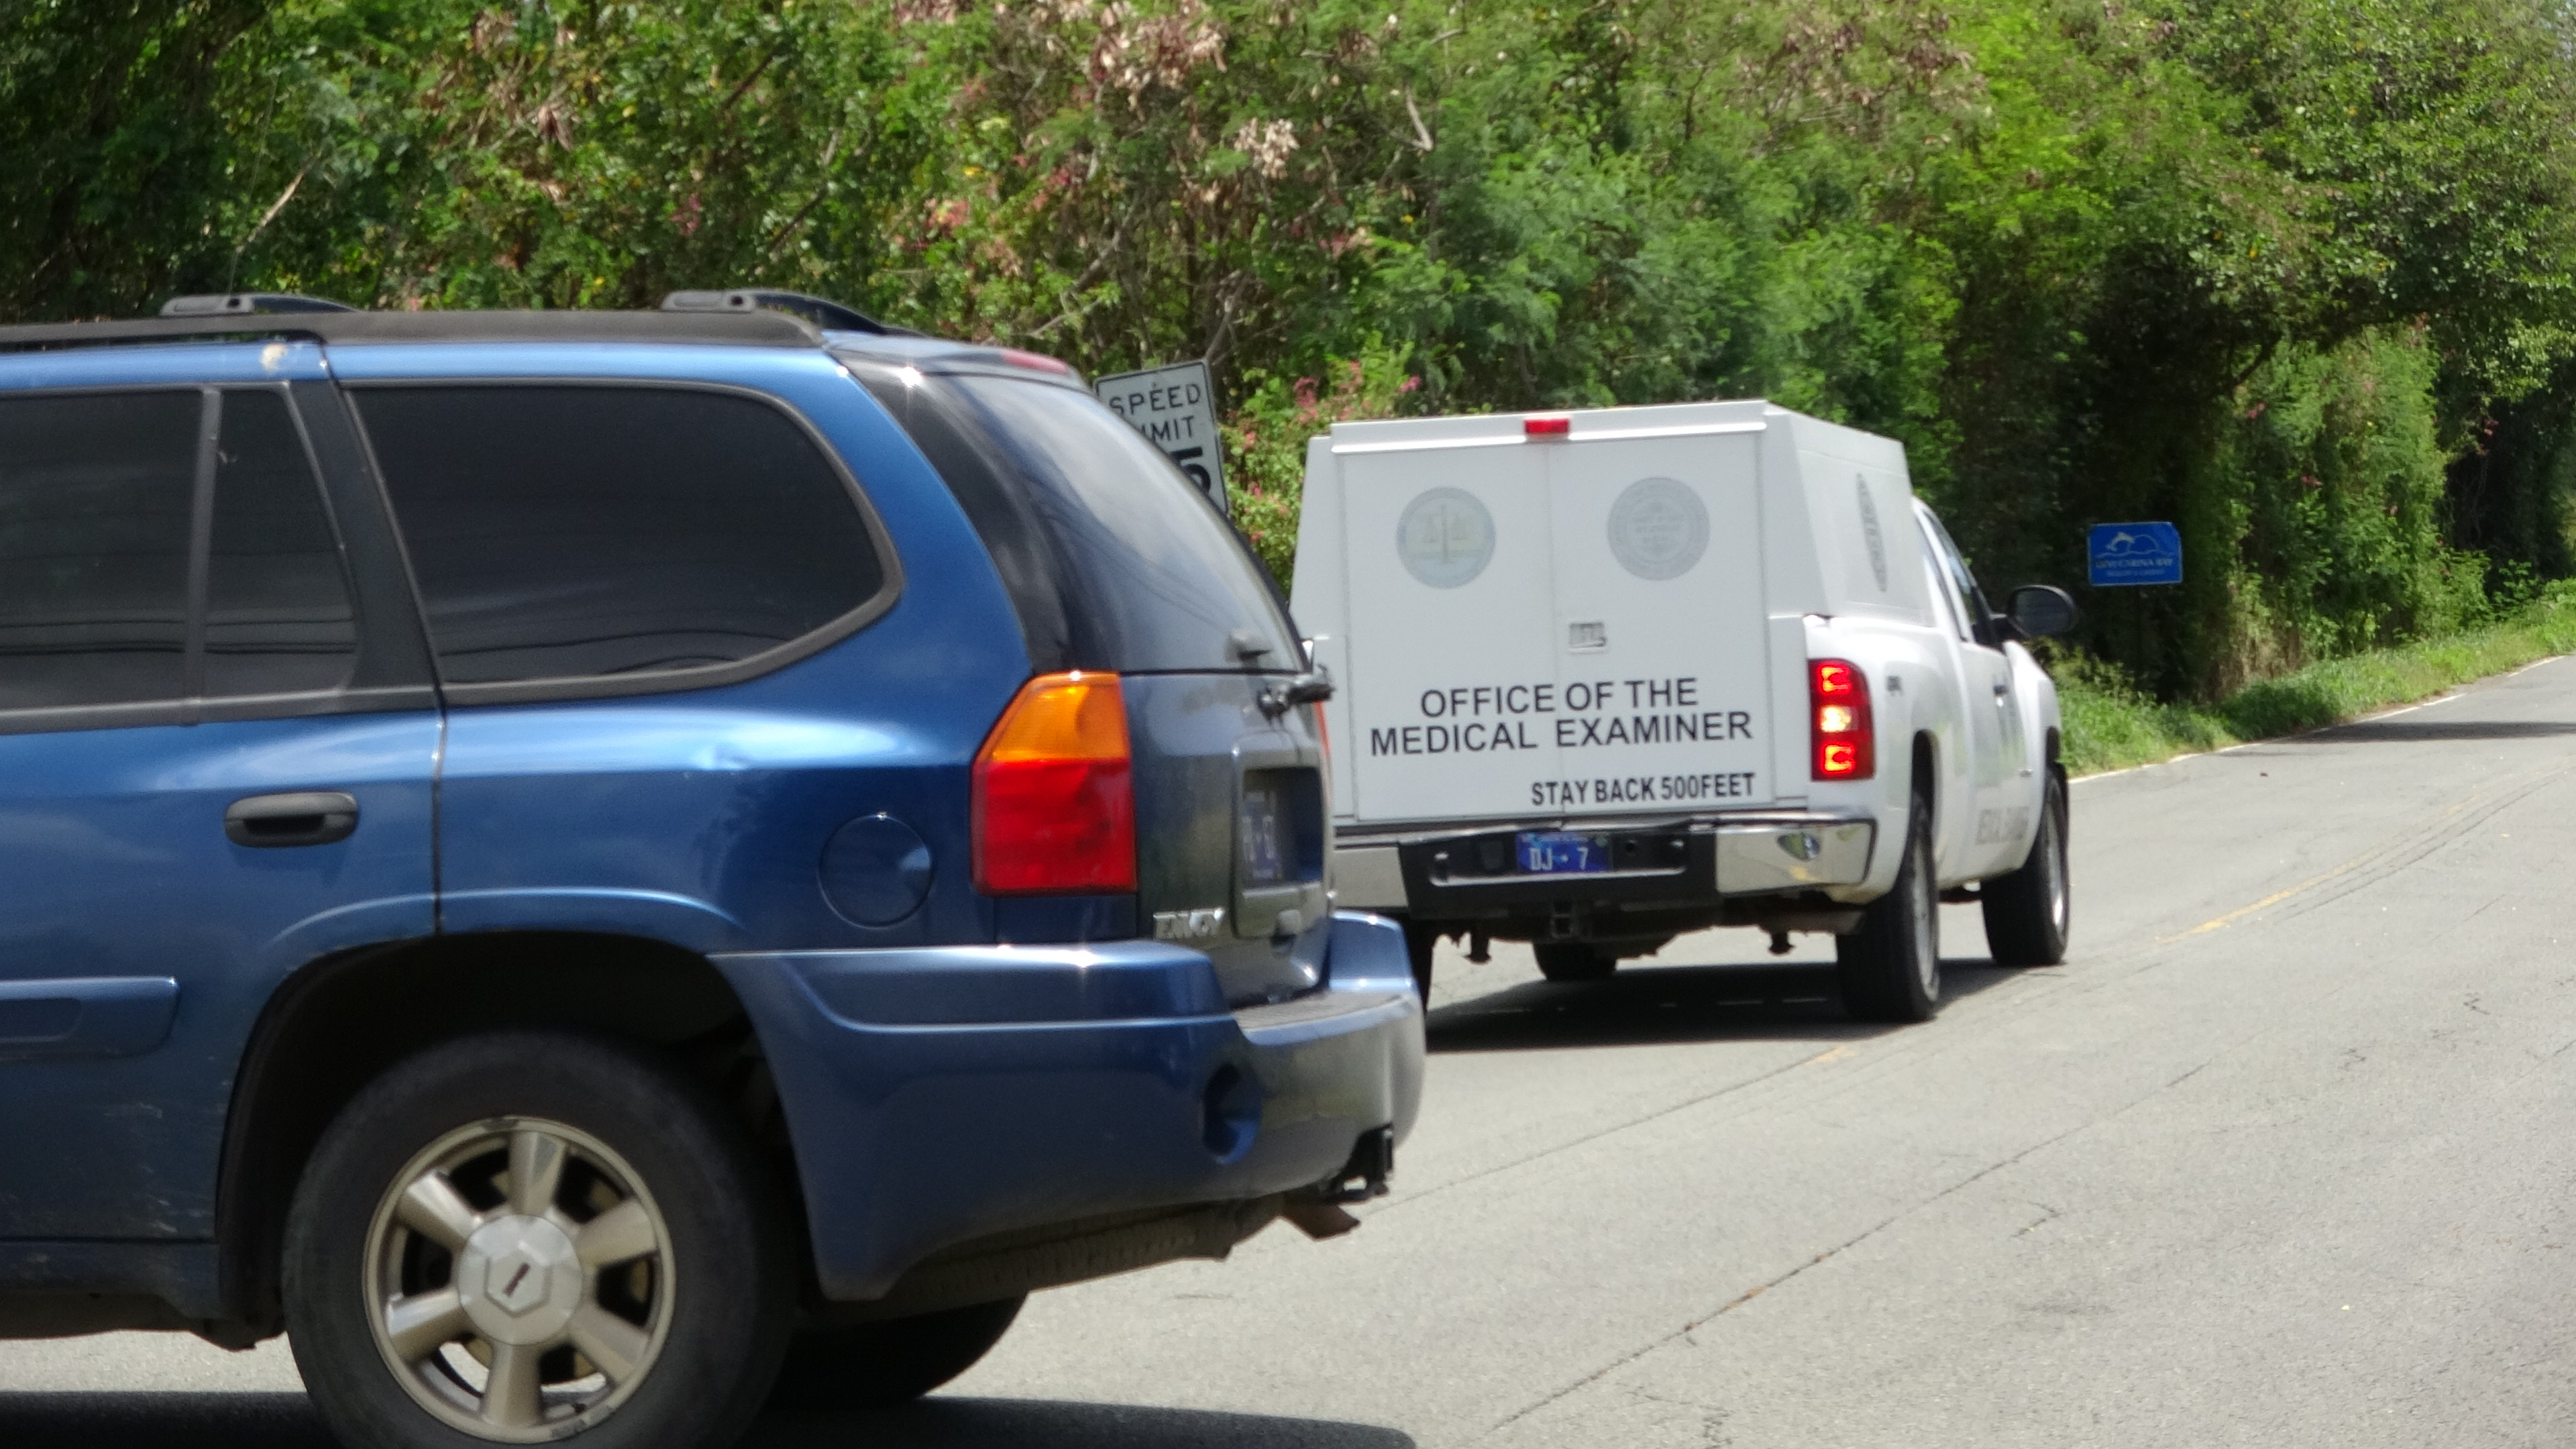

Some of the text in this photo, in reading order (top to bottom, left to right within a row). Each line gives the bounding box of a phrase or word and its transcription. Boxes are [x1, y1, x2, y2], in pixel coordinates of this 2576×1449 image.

[1109, 383, 1201, 416] SPEED
[1140, 415, 1195, 442] IMIT
[1169, 445, 1212, 494] 5
[1420, 677, 1699, 718] OFFICE OF THE
[1371, 711, 1753, 757] MEDICAL EXAMINER
[1531, 778, 1589, 806] STAY
[1595, 776, 1656, 802] BACK
